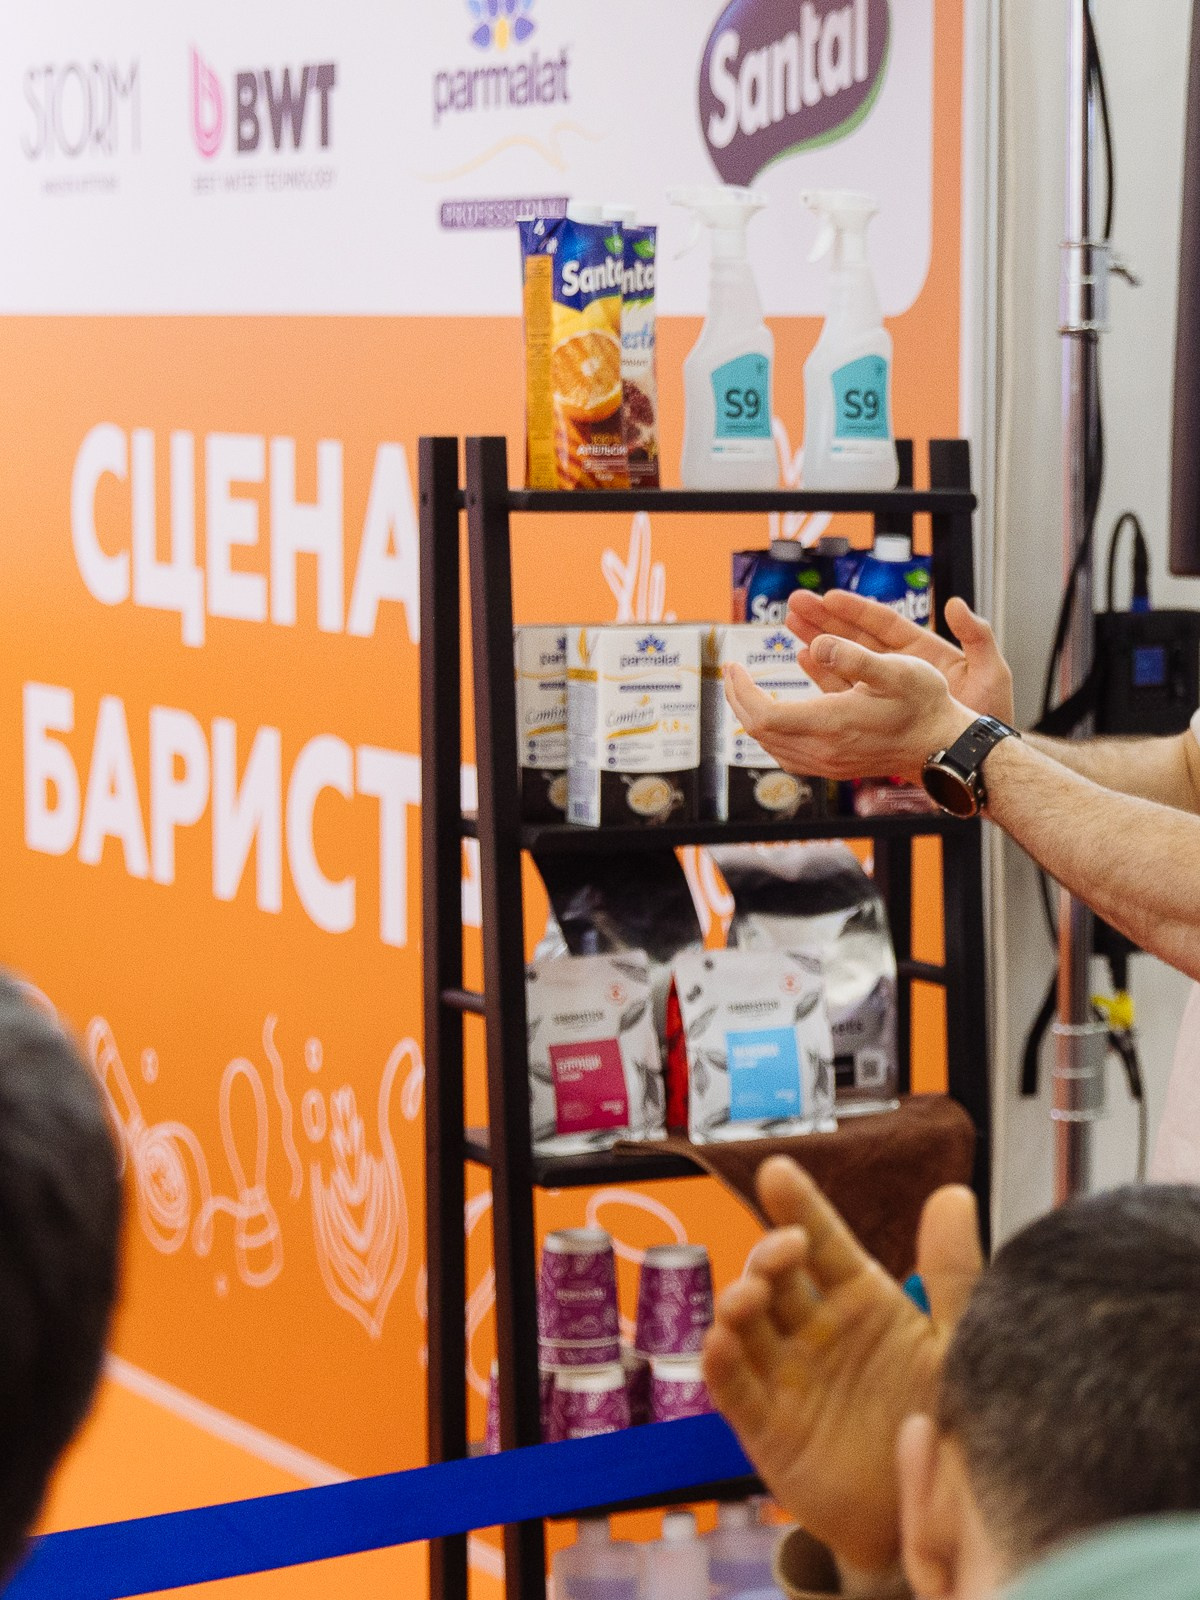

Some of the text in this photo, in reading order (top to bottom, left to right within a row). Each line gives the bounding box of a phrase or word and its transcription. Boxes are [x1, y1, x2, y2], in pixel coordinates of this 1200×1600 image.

[235, 62, 338, 154] BWT
[434, 46, 571, 127] parmalat
[709, 0, 871, 149] Santal
[561, 255, 623, 298] Santa
[724, 387, 761, 419] S9
[843, 389, 880, 420] S9
[70, 421, 420, 648] СЦЕНА
[22, 680, 483, 948] БАРИСТ
